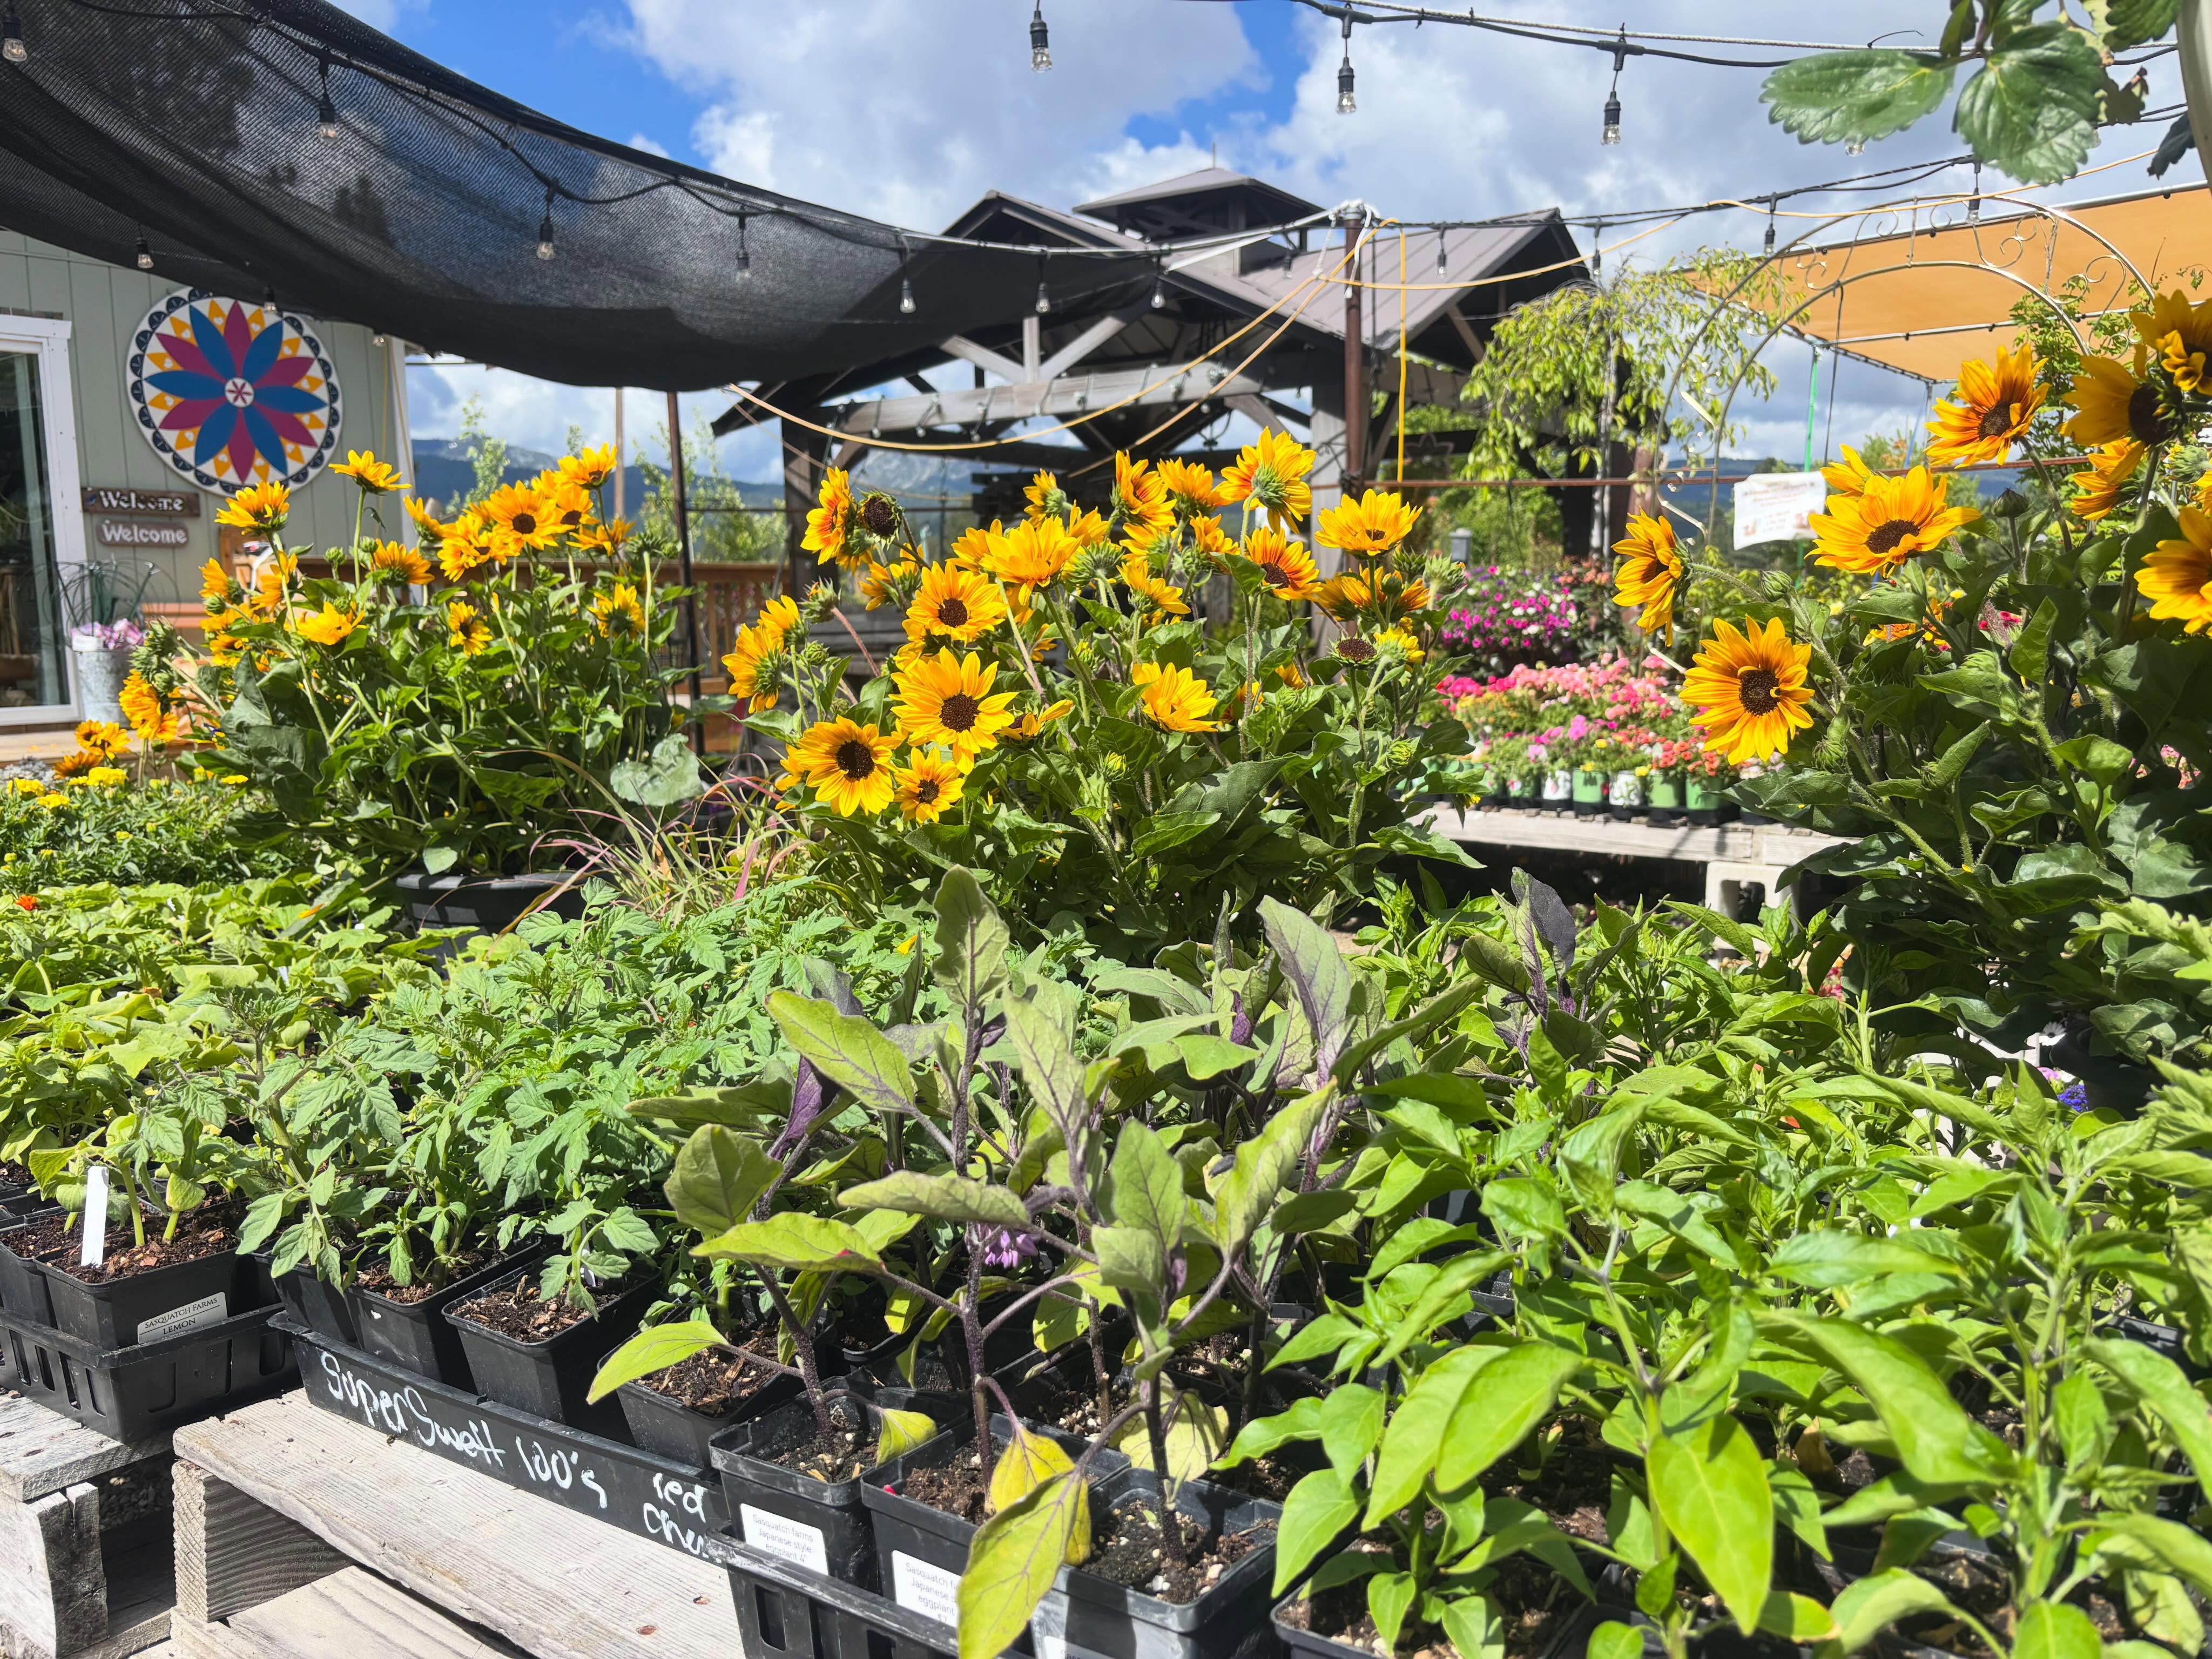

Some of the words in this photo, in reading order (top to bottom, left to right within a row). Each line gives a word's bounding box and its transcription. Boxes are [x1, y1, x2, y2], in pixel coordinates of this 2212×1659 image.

[99, 490, 184, 511] Welcome
[102, 523, 187, 544] Welcome
[145, 1307, 191, 1328] SASQUATCH
[193, 1297, 218, 1312] FARMS
[163, 1318, 196, 1335] LEMON
[516, 1435, 607, 1508] 100's
[653, 1473, 706, 1523] red
[752, 1514, 790, 1534] Sasquatch
[792, 1528, 813, 1542] farms
[758, 1529, 792, 1547] Japanese
[794, 1541, 812, 1554] style
[906, 1562, 948, 1588] Sasquatch
[911, 1577, 949, 1600] Japanese
[918, 1595, 955, 1615] eggplant
